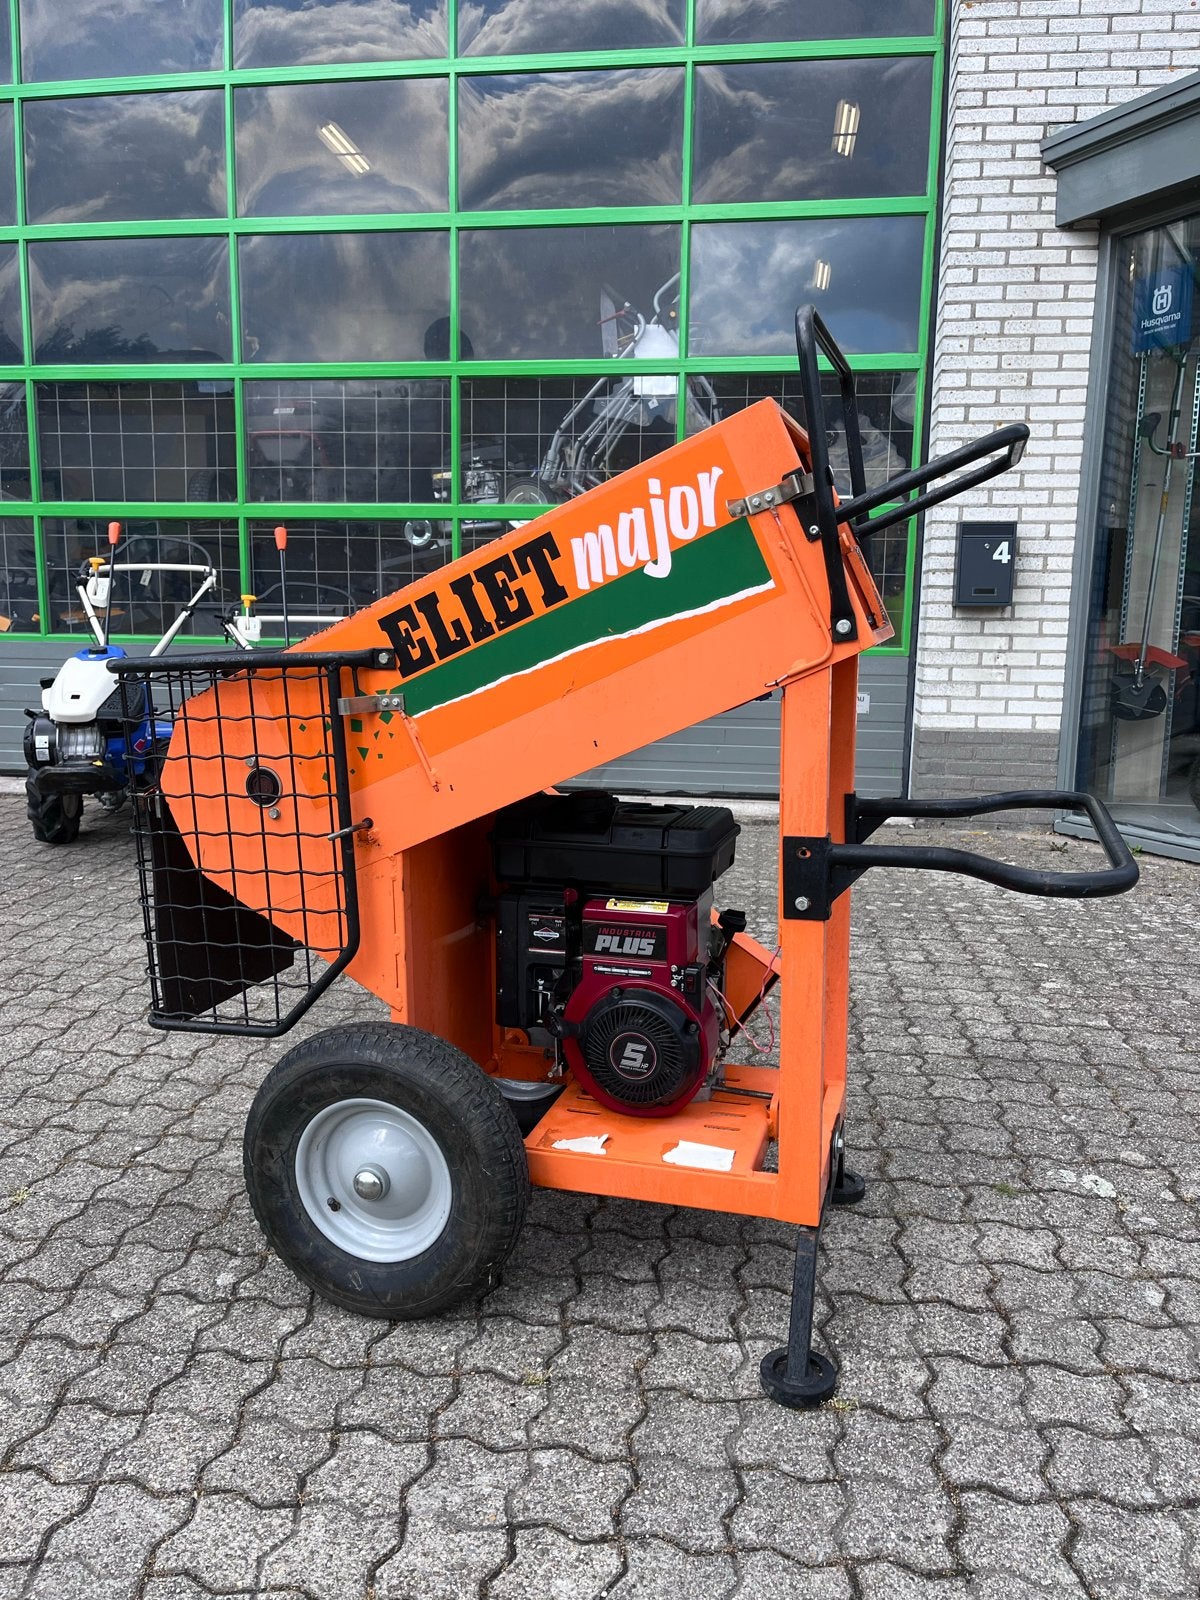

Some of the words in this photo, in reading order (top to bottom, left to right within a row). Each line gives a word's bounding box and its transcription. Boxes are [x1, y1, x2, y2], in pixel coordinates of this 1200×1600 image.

[1141, 312, 1181, 329] Husqvarna
[992, 541, 1012, 564] 4
[377, 531, 569, 679] ELIET
[570, 466, 724, 590] major
[598, 927, 657, 939] INDUSTRIAL
[594, 934, 656, 956] PLUS
[620, 1042, 648, 1068] 5
